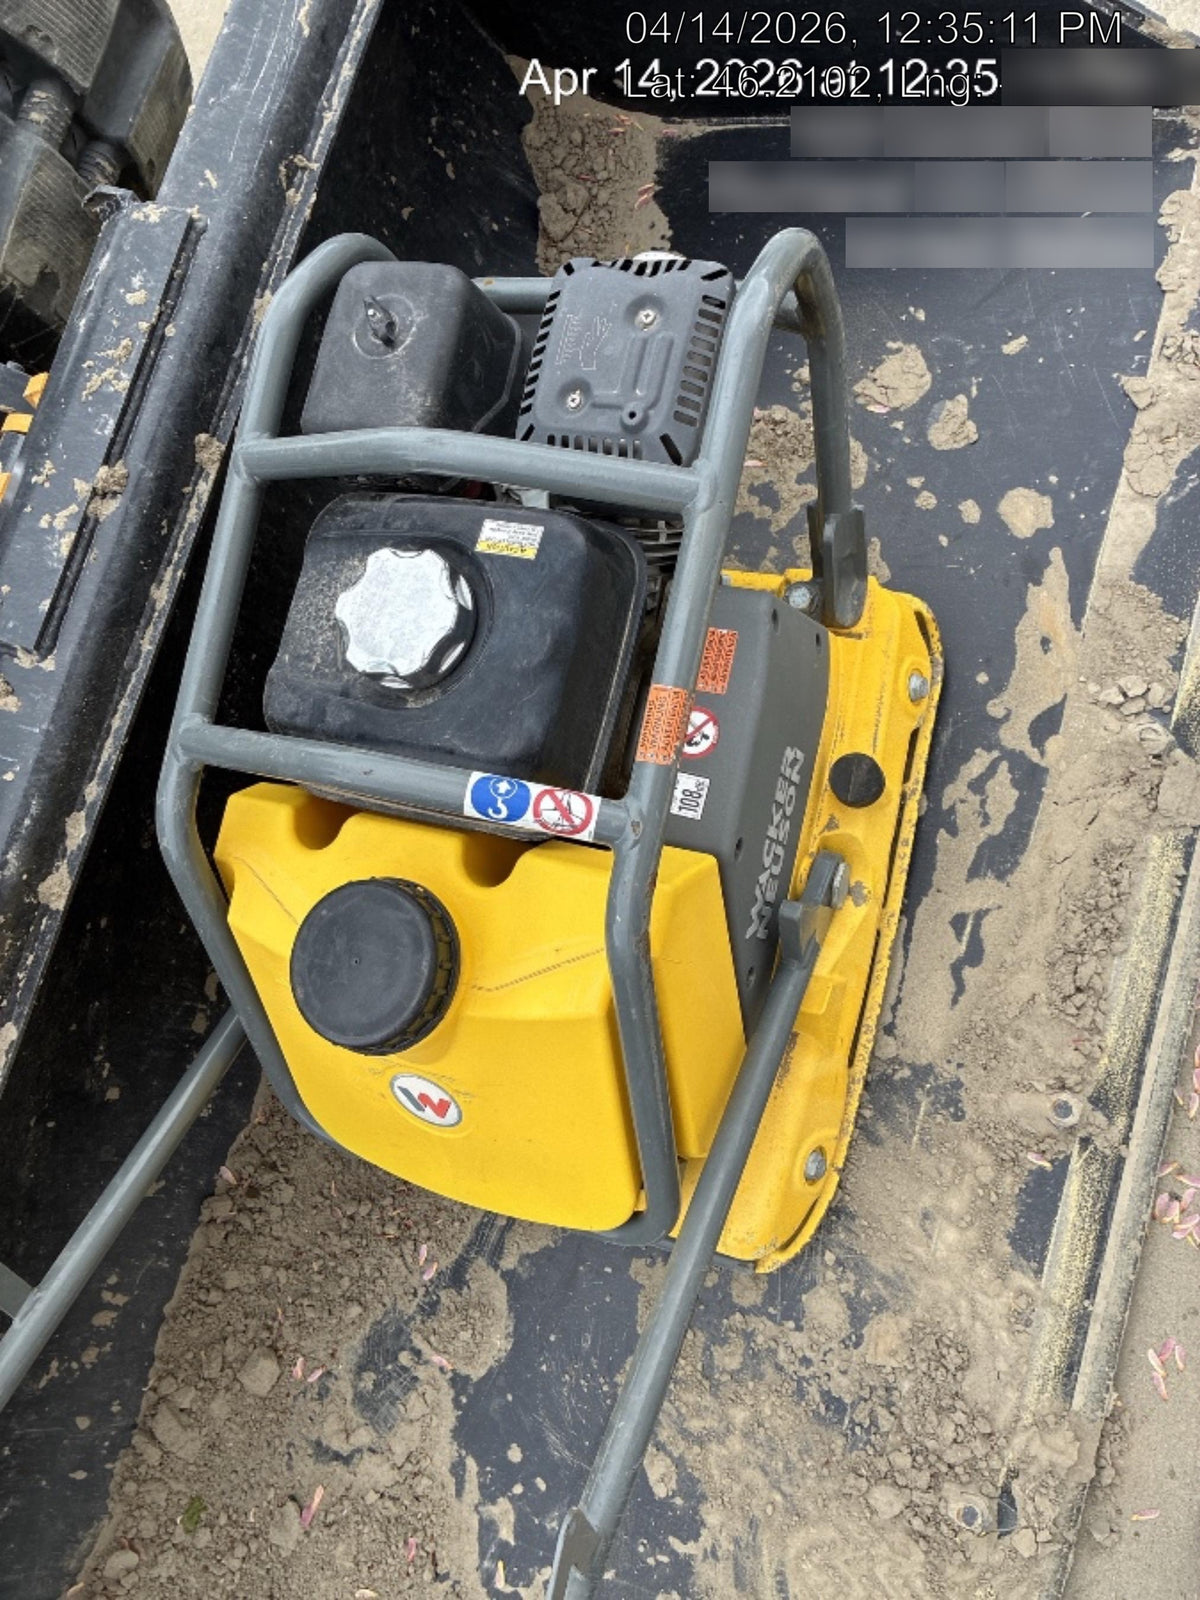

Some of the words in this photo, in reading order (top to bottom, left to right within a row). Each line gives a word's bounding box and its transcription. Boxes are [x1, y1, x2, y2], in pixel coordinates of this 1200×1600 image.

[678, 788, 703, 813] 108
[745, 746, 792, 939] WACKER
[757, 747, 805, 940] NEUSON
